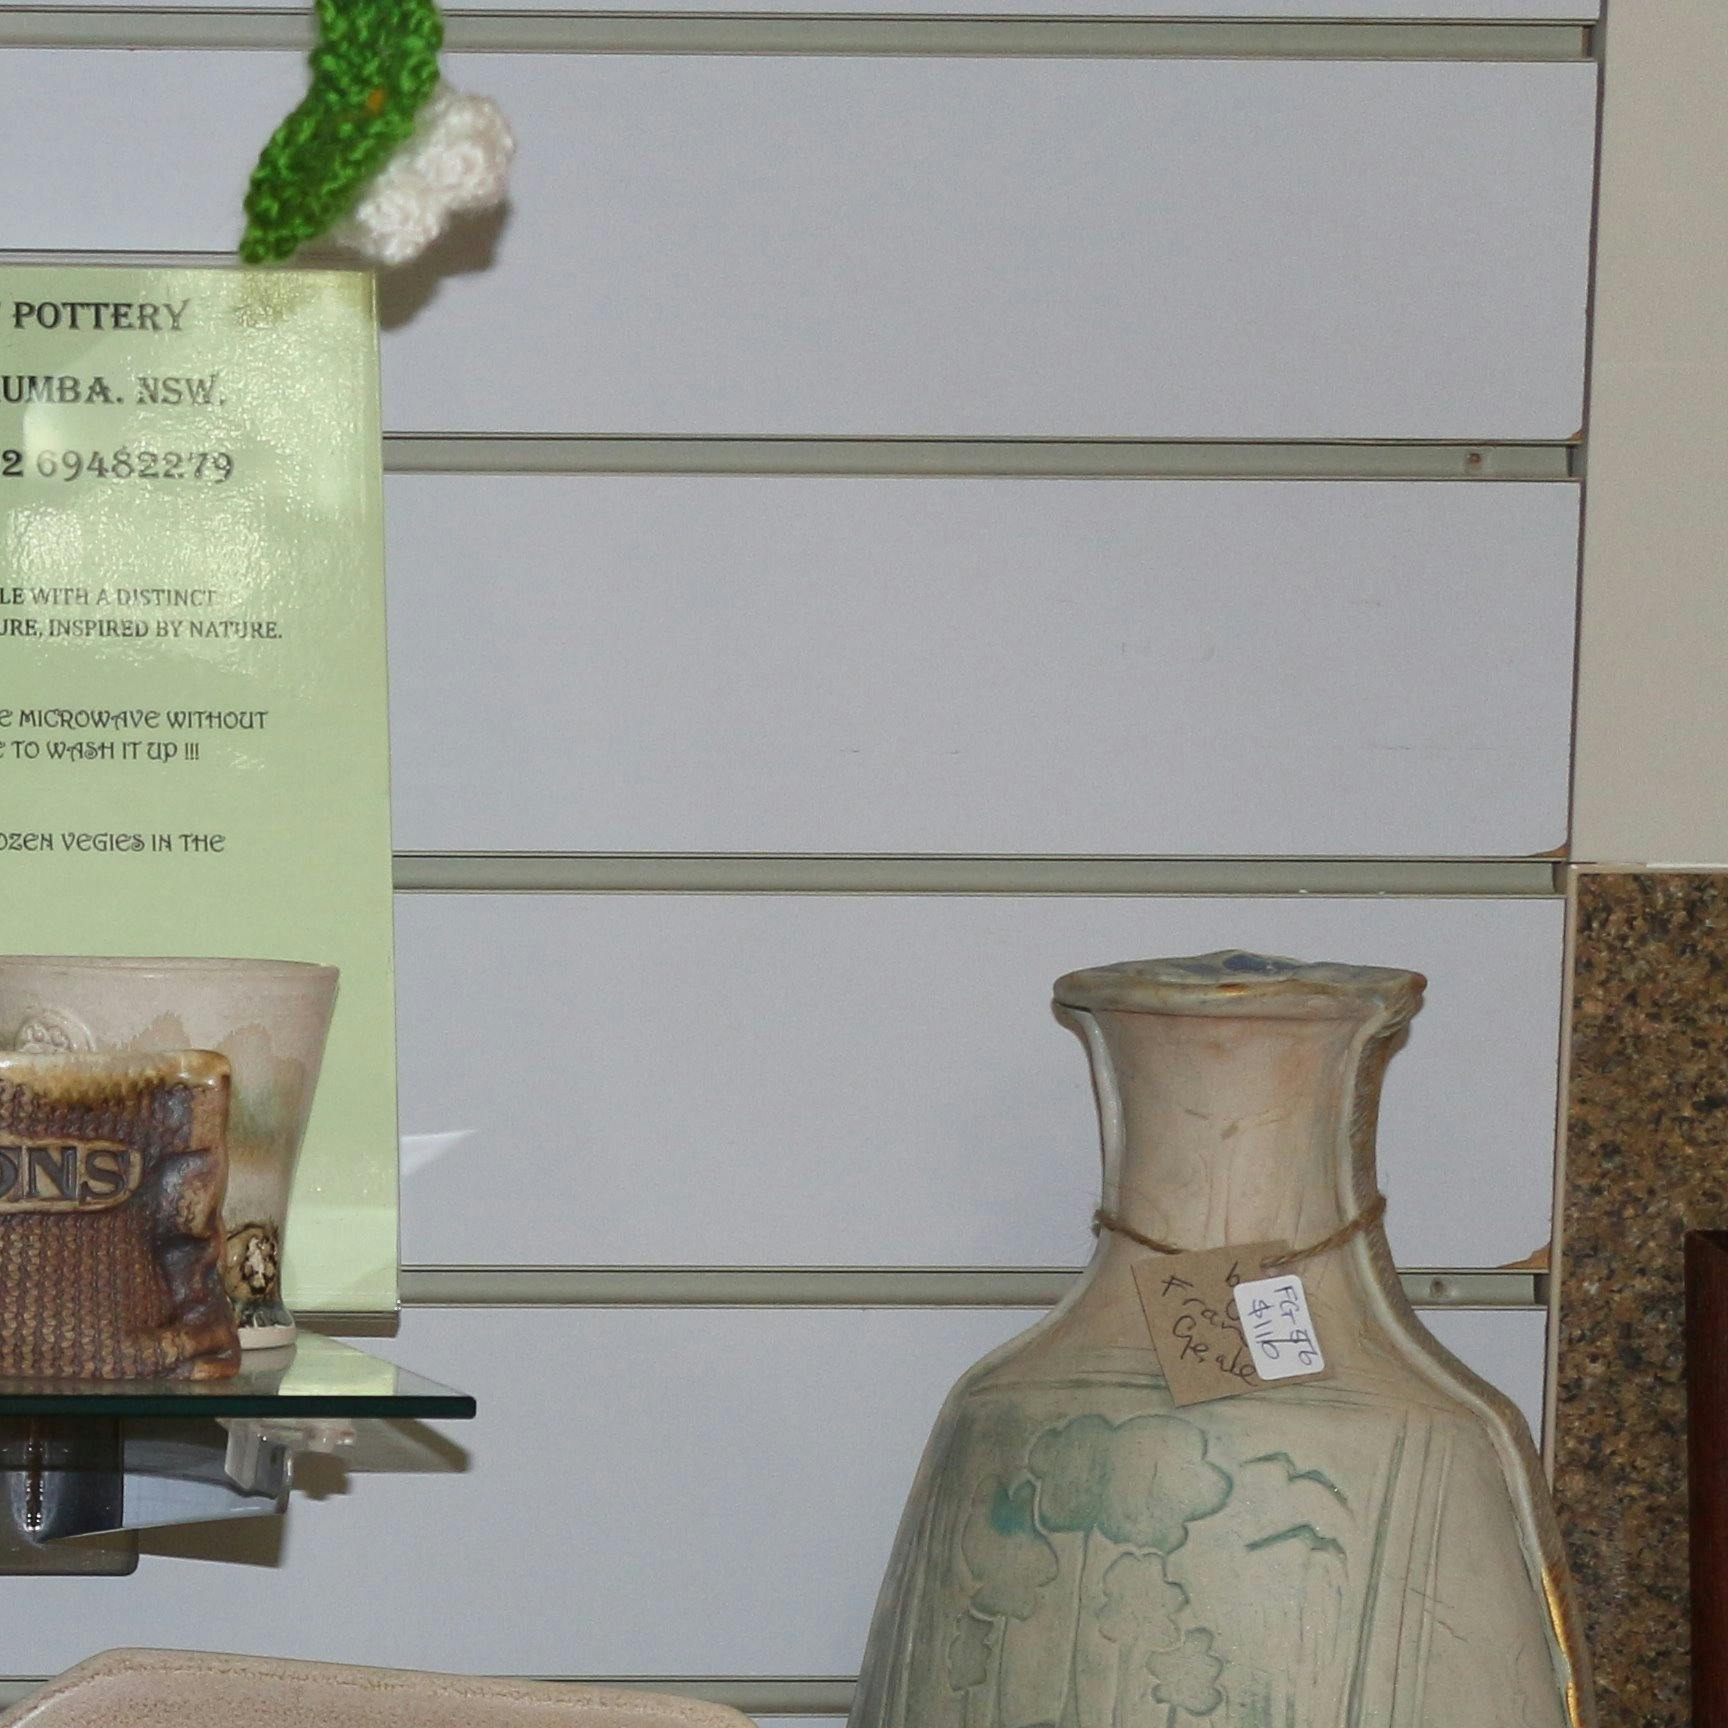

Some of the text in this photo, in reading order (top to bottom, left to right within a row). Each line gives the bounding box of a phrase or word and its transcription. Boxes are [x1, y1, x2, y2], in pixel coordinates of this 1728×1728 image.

[14, 300, 191, 331] POTTERY
[137, 374, 226, 405] NSW.
[37, 449, 235, 483] 69482279
[29, 588, 89, 606] WITH
[96, 588, 111, 606] A
[117, 588, 217, 607] DISTINCT
[49, 619, 148, 637] INSPIRED
[156, 620, 183, 638] BY
[189, 621, 282, 639] NATURE.
[19, 708, 160, 730] MICROWAVE
[167, 710, 268, 729] WITHOUT
[11, 741, 40, 758] TO
[47, 741, 115, 761] WASH
[122, 742, 143, 759] IT
[147, 742, 178, 762] UP
[185, 743, 200, 760] !!!
[61, 833, 145, 852] VEGIES
[152, 834, 172, 852] IN
[179, 833, 226, 853] THE
